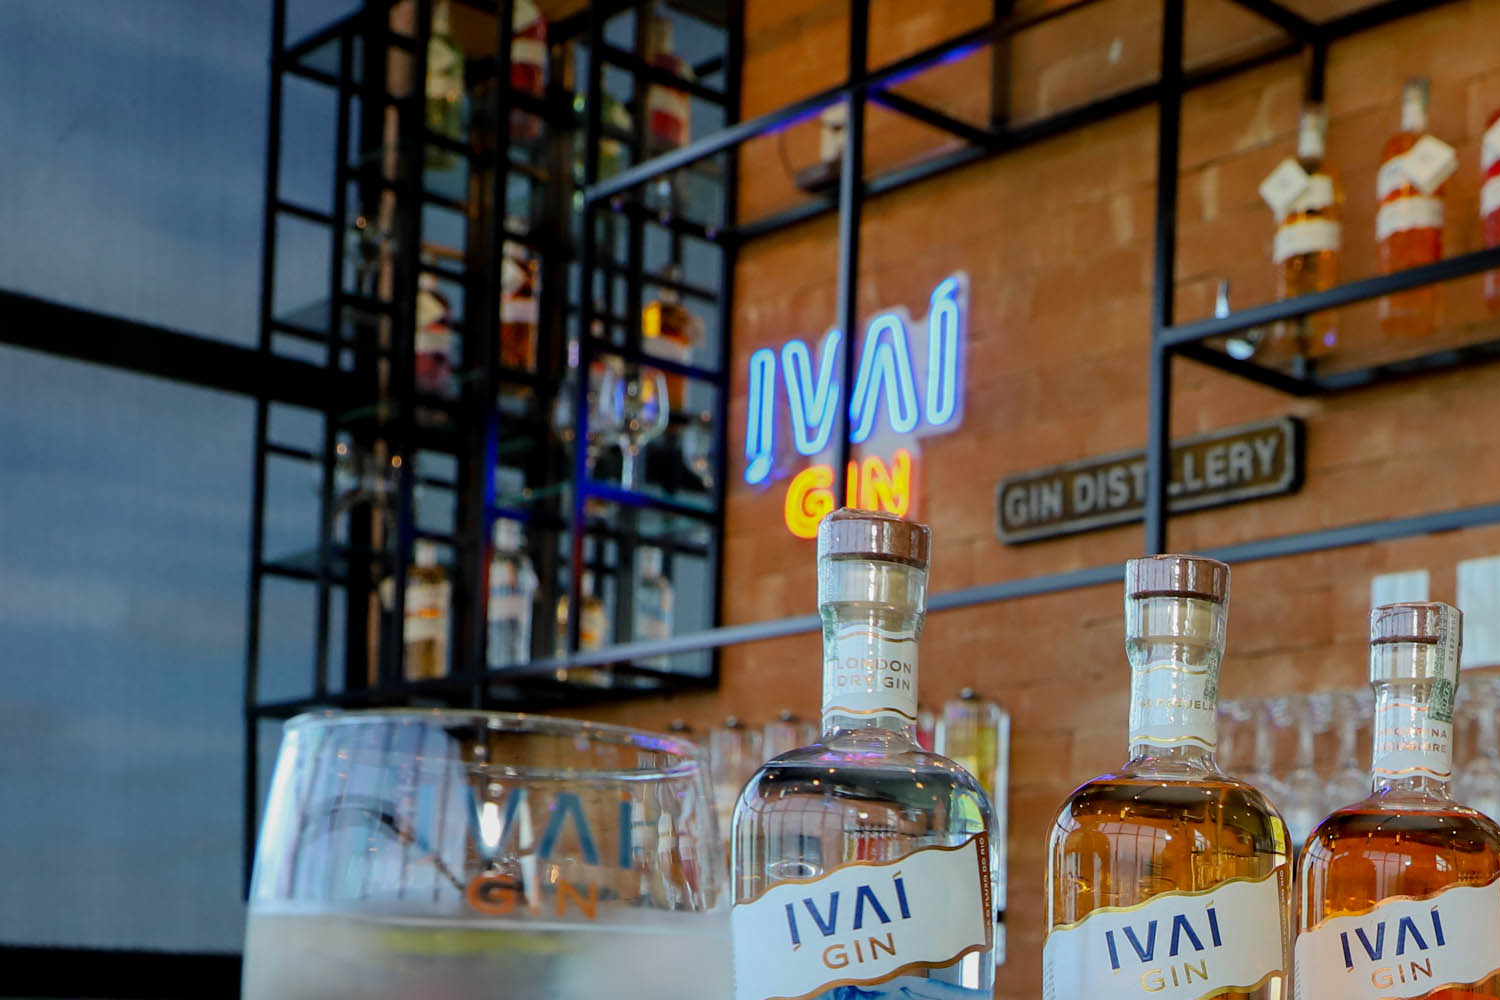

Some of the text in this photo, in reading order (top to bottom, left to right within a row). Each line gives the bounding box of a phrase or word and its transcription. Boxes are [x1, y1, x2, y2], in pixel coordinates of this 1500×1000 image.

[785, 448, 911, 539] GIN
[1005, 436, 1278, 526] GIN DISTLERY
[836, 656, 911, 674] LONDON
[837, 674, 911, 690] DRY GIN
[822, 933, 897, 970] GIN
[1141, 959, 1209, 993] GIN
[1371, 958, 1433, 989] GIN
